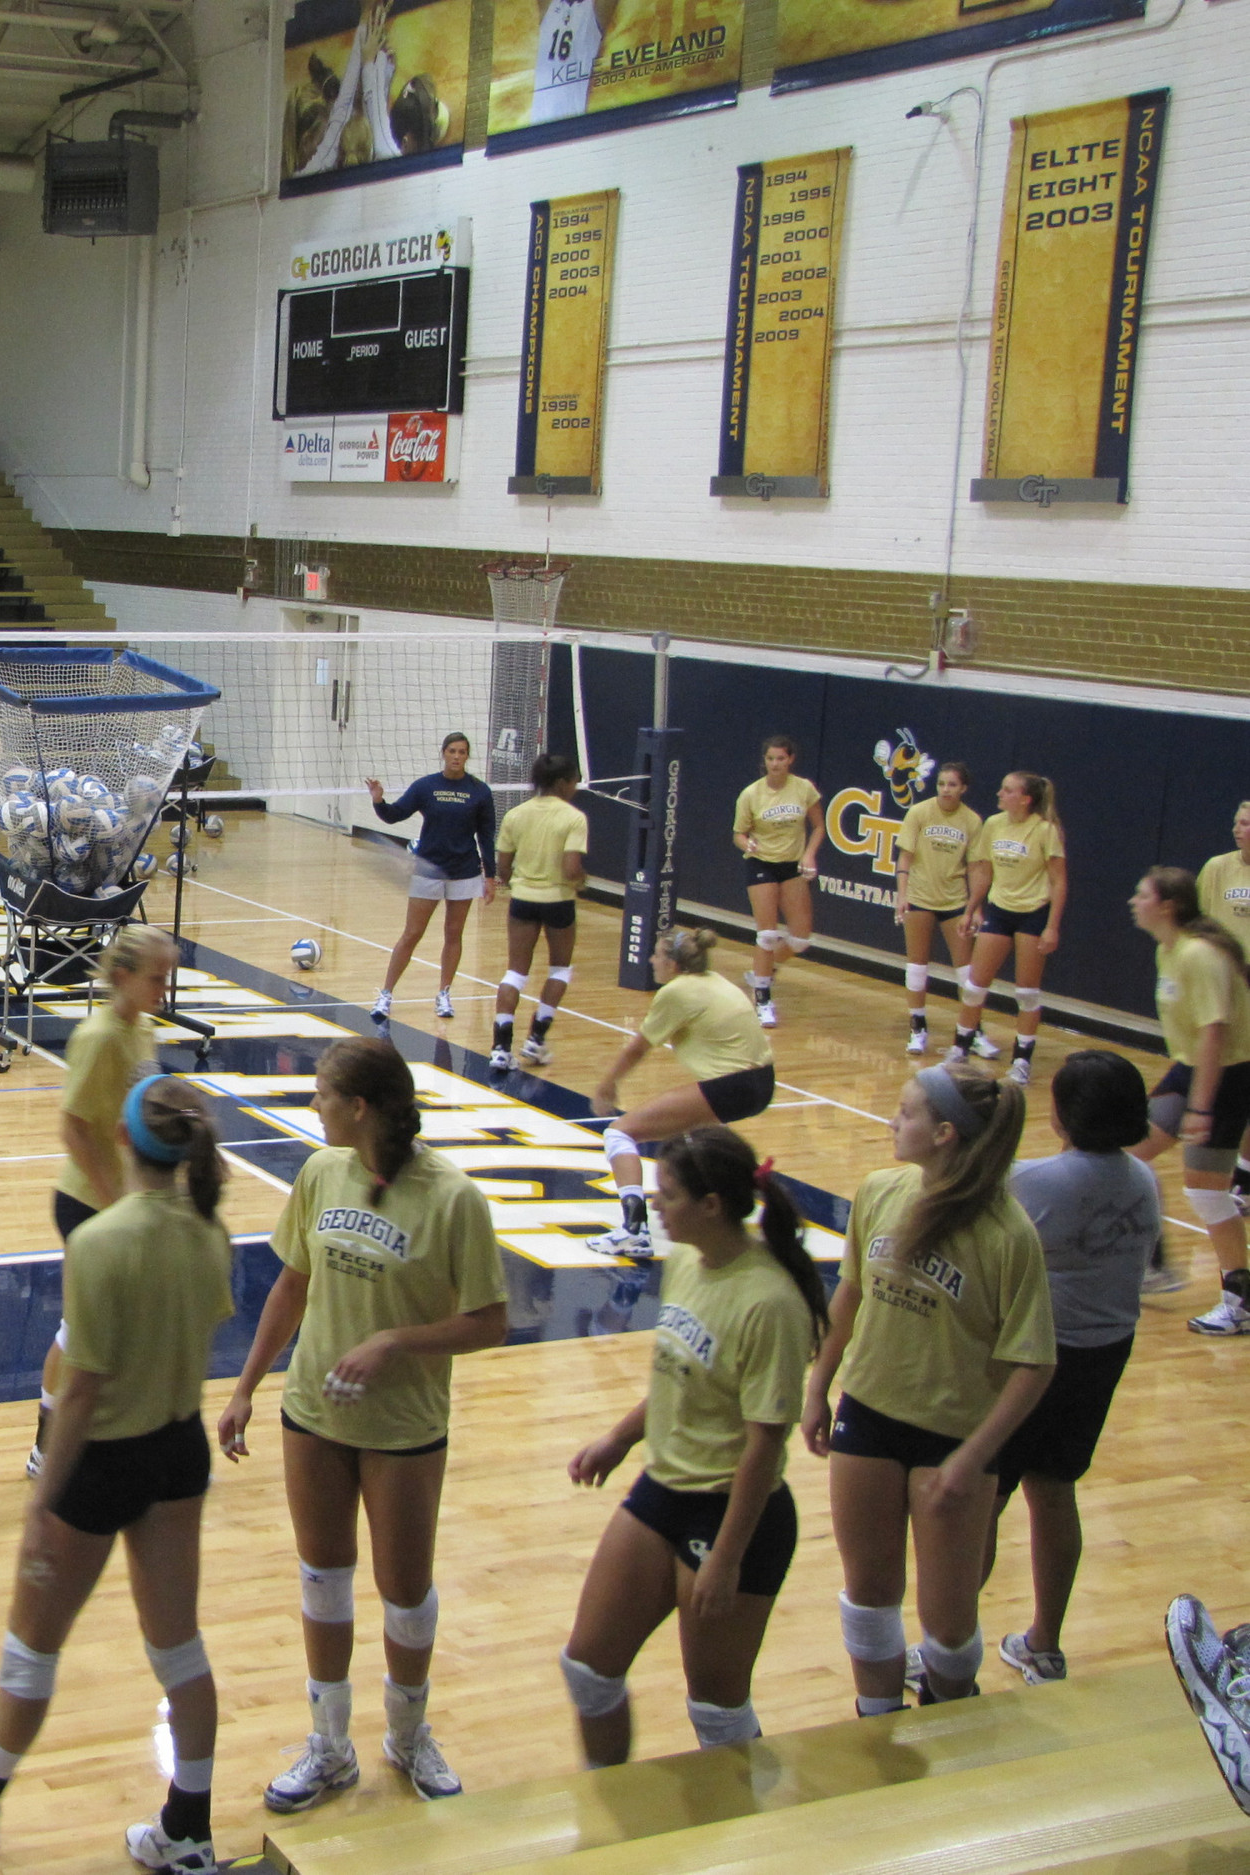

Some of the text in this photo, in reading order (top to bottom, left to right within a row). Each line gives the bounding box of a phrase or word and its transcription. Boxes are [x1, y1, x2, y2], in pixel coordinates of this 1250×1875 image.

[548, 28, 573, 61] 16
[610, 25, 726, 70] EVELAND
[593, 49, 725, 88] 2003 ALL-AMERICAN
[1030, 139, 1121, 171] ELITE
[765, 170, 807, 188] 1994
[1028, 171, 1117, 201] EIGHT
[789, 186, 831, 203] 1995
[553, 213, 590, 229] 1994
[763, 210, 805, 227] 1996
[1025, 202, 1113, 231] 2003
[565, 229, 602, 245] 1995
[783, 227, 830, 243] 2000
[310, 242, 382, 278] GEORGIA
[386, 234, 433, 266] TECH
[551, 249, 589, 264] 2000
[760, 251, 802, 265] 2001
[560, 265, 600, 281] 2003
[781, 267, 827, 283] 2002
[1111, 107, 1155, 435] NCAA TOURNAMENT
[548, 285, 587, 300] 2004
[758, 290, 802, 304] 2003
[525, 214, 544, 413] ACC CHAMPIONS
[729, 178, 756, 441] NCAA TOURNAMENT
[778, 307, 825, 322] 2004
[292, 327, 447, 359] HOME PERIOD GUEST
[754, 329, 799, 343] 2009
[986, 260, 1010, 473] GEORGIA TECH VOLLEYBALL
[541, 400, 578, 412] 1995
[551, 417, 590, 429] 2002
[297, 432, 330, 454] Delta
[338, 441, 367, 450] GEORGIA
[356, 451, 379, 460] POWER
[1019, 474, 1058, 508] GT
[433, 790, 471, 799] GEORGIA TECH
[661, 760, 680, 873] GEORGIA
[762, 804, 806, 821] GEORGIA
[826, 787, 906, 877] GT
[924, 825, 966, 842] GEORGIA
[628, 914, 643, 964] Senoh
[316, 1208, 408, 1260] GEORGIA
[324, 1245, 385, 1273] TECH
[872, 1274, 937, 1309] TECH
[872, 1288, 930, 1318] VOLLEYBALL
